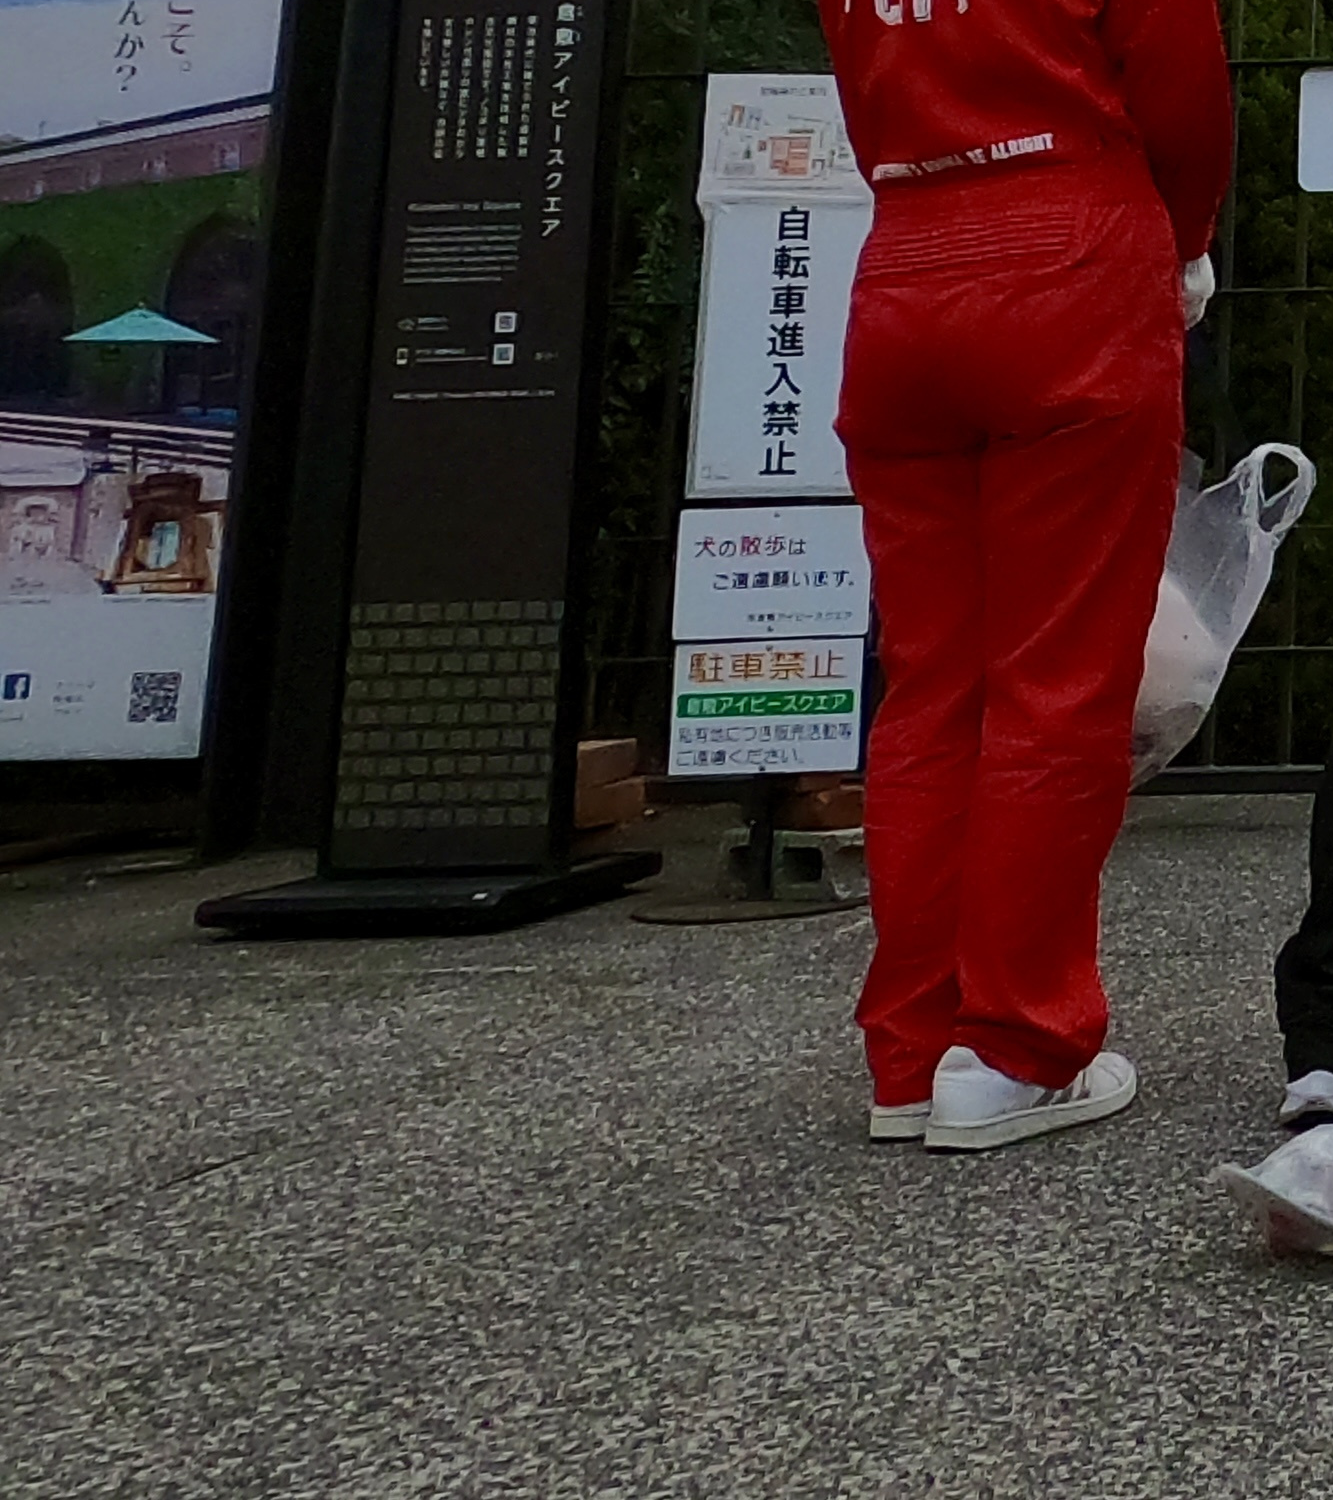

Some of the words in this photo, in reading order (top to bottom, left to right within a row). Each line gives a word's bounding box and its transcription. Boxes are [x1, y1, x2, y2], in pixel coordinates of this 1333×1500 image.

[759, 204, 812, 478] 自転車進入禁止
[694, 535, 807, 558] 犬の散歩は
[688, 649, 848, 684] 駐車禁止
